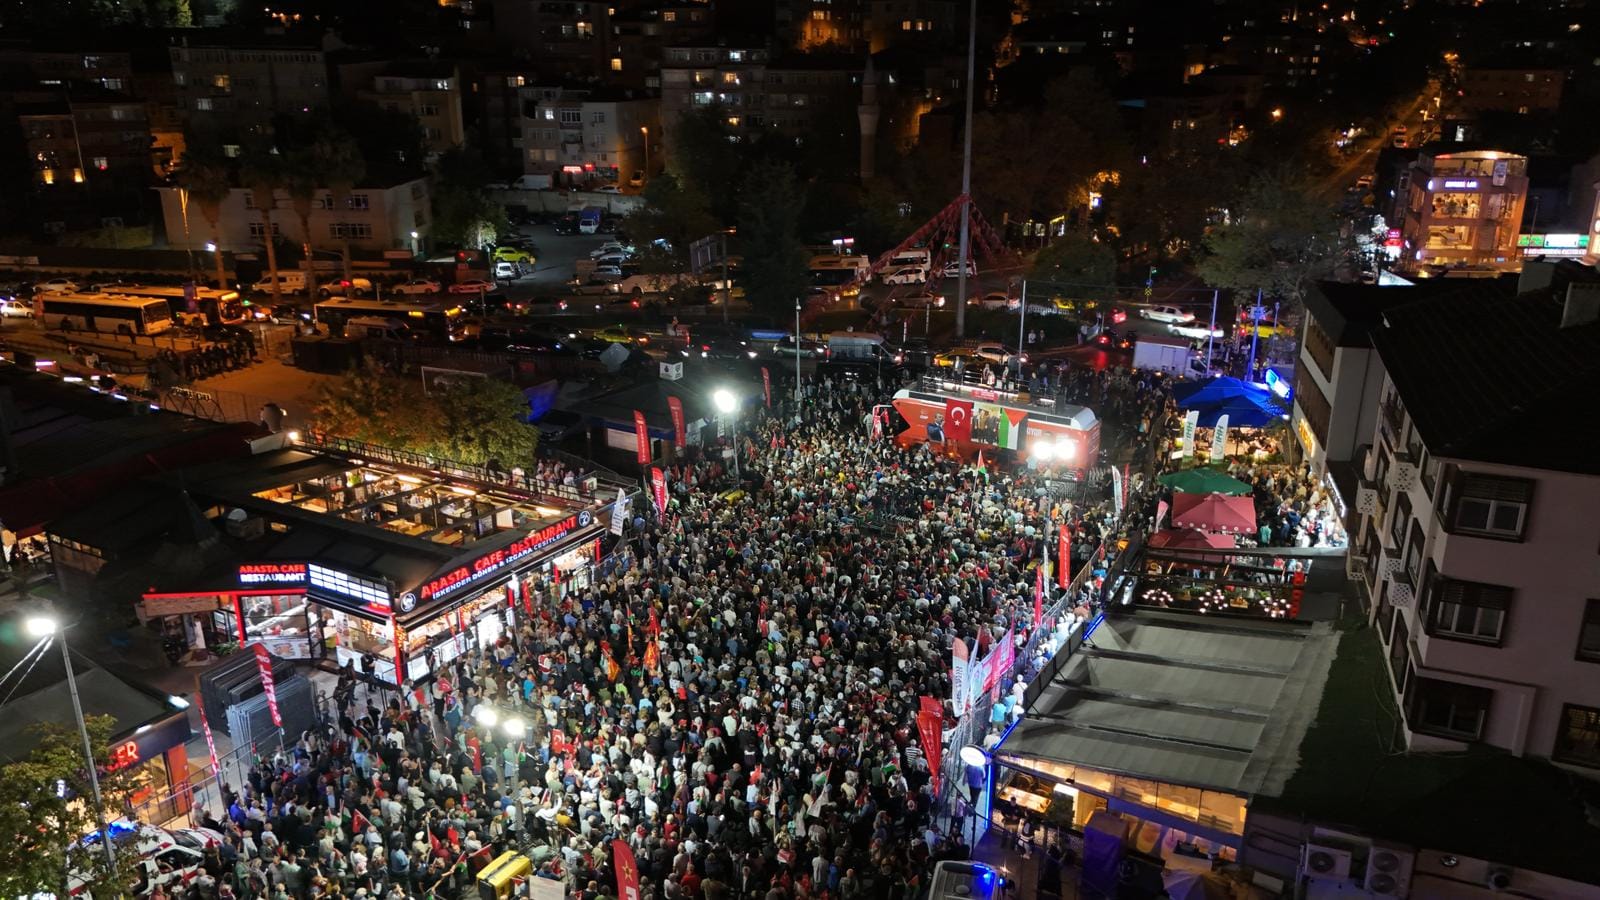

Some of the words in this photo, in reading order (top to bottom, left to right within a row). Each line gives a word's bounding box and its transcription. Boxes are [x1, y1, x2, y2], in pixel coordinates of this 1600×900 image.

[420, 565, 470, 599] ARASTA
[473, 549, 503, 571] CAFE
[510, 515, 577, 554] RESTAURANT
[239, 565, 279, 573] ARASTA
[280, 564, 306, 573] CAFE
[240, 573, 306, 582] RESTAURANT
